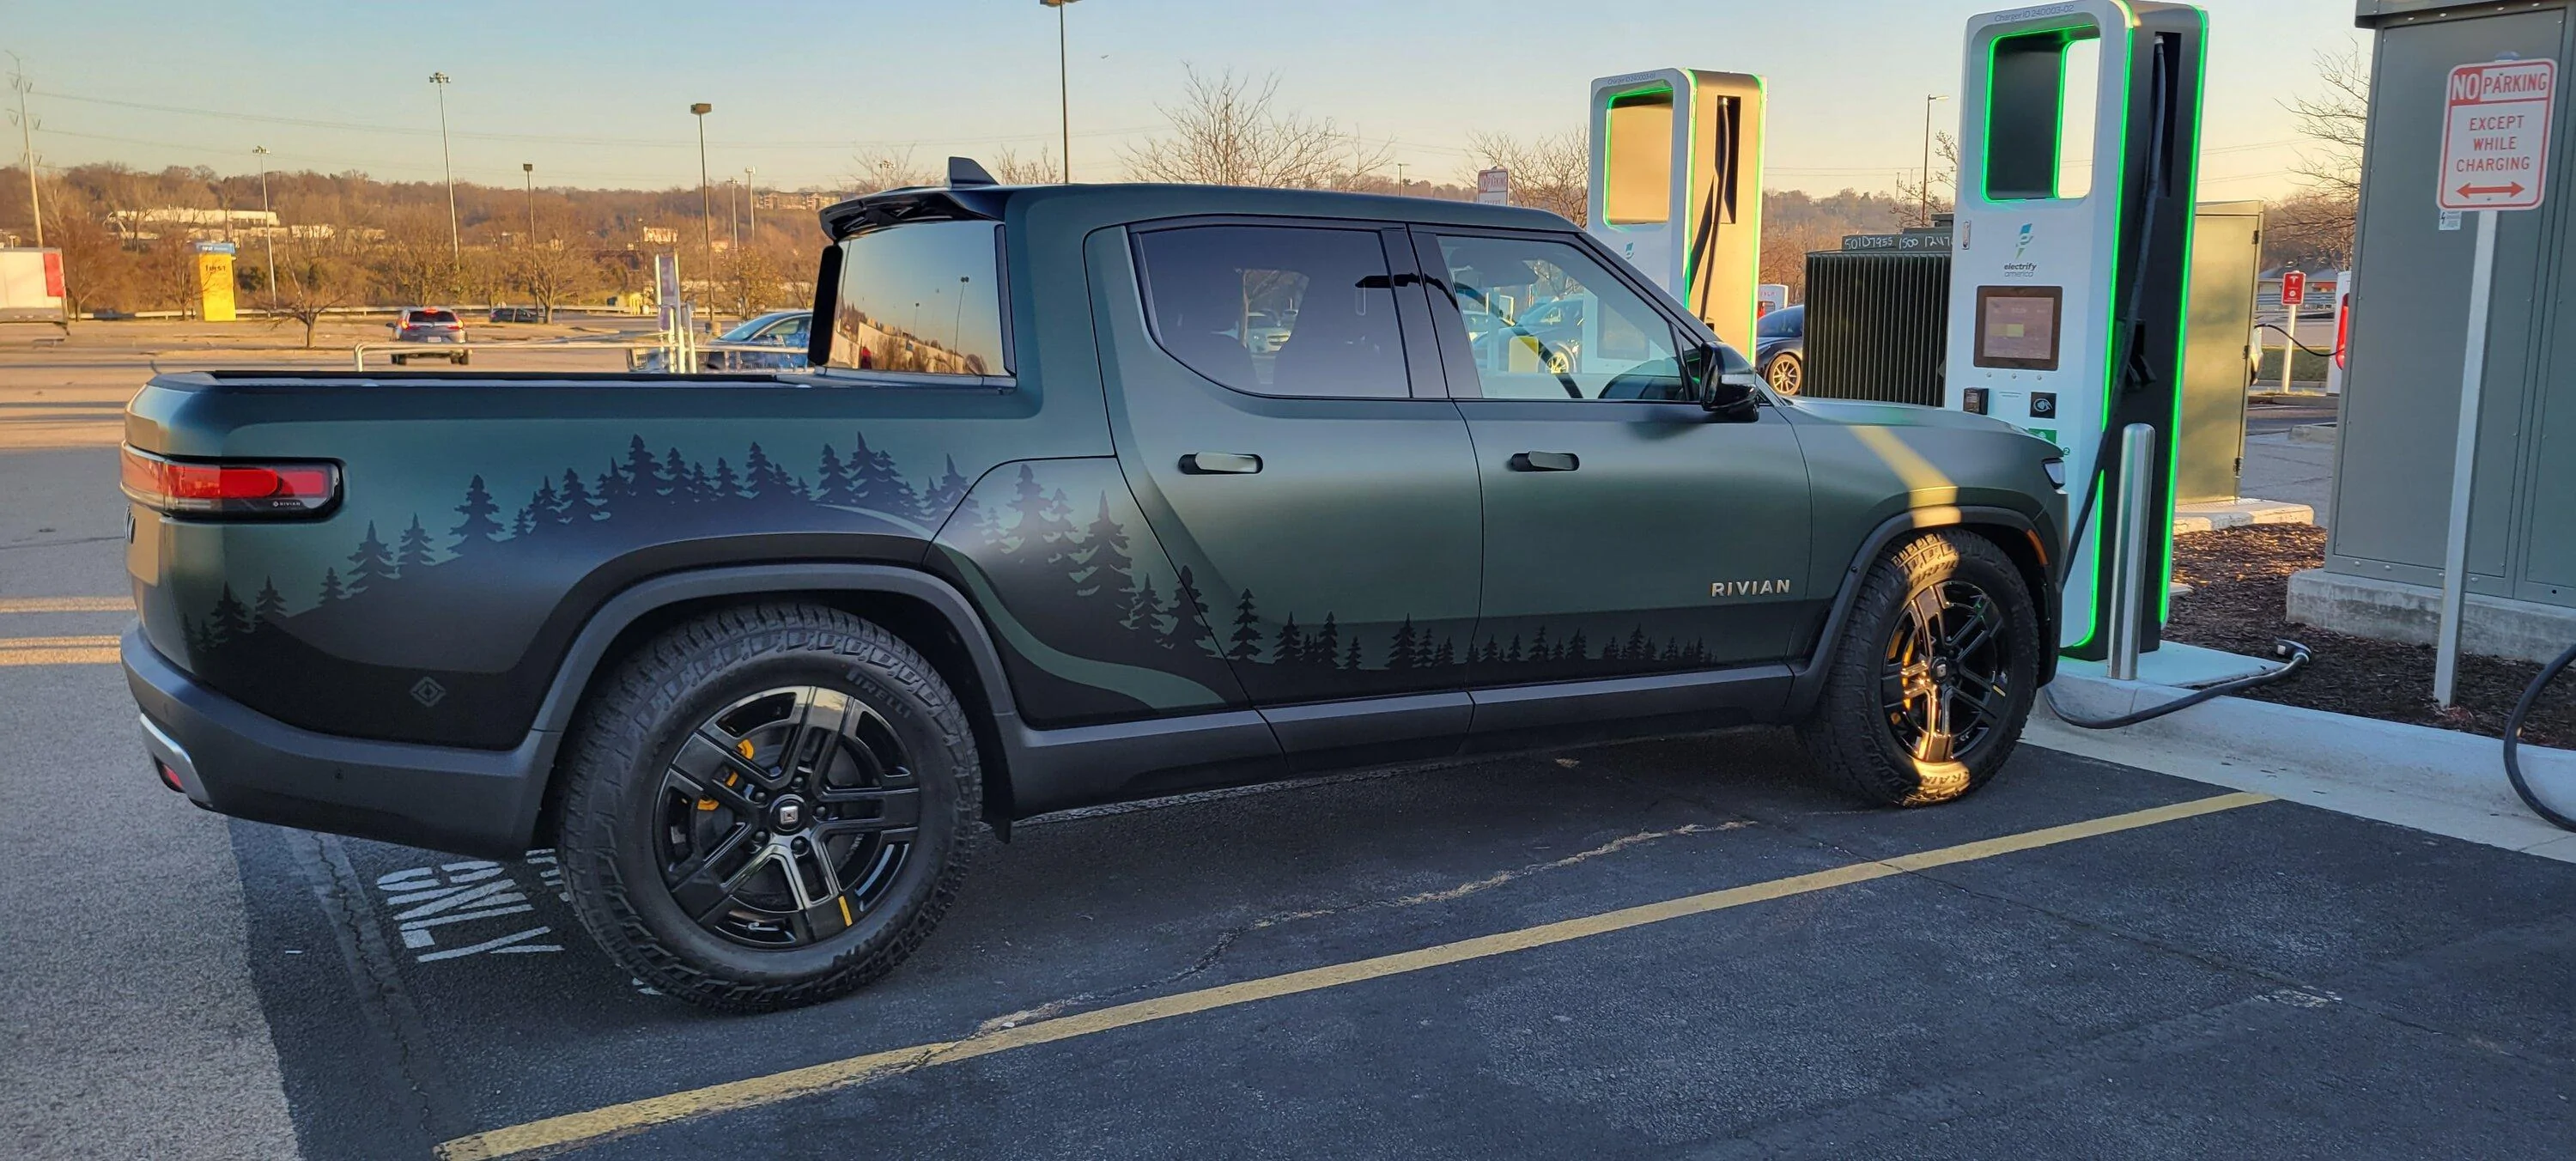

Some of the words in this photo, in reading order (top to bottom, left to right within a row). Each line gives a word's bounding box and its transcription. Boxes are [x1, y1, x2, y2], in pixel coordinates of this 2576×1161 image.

[2451, 72, 2481, 100] NO
[2483, 72, 2548, 94] PARKING
[2469, 115, 2524, 131] EXCEPT
[2473, 136, 2518, 151] WHILE
[2456, 156, 2530, 173] CHARGING
[2003, 263, 2037, 271] electrify
[1711, 579, 1790, 598] RIVIAN
[376, 860, 565, 963] ONLY
